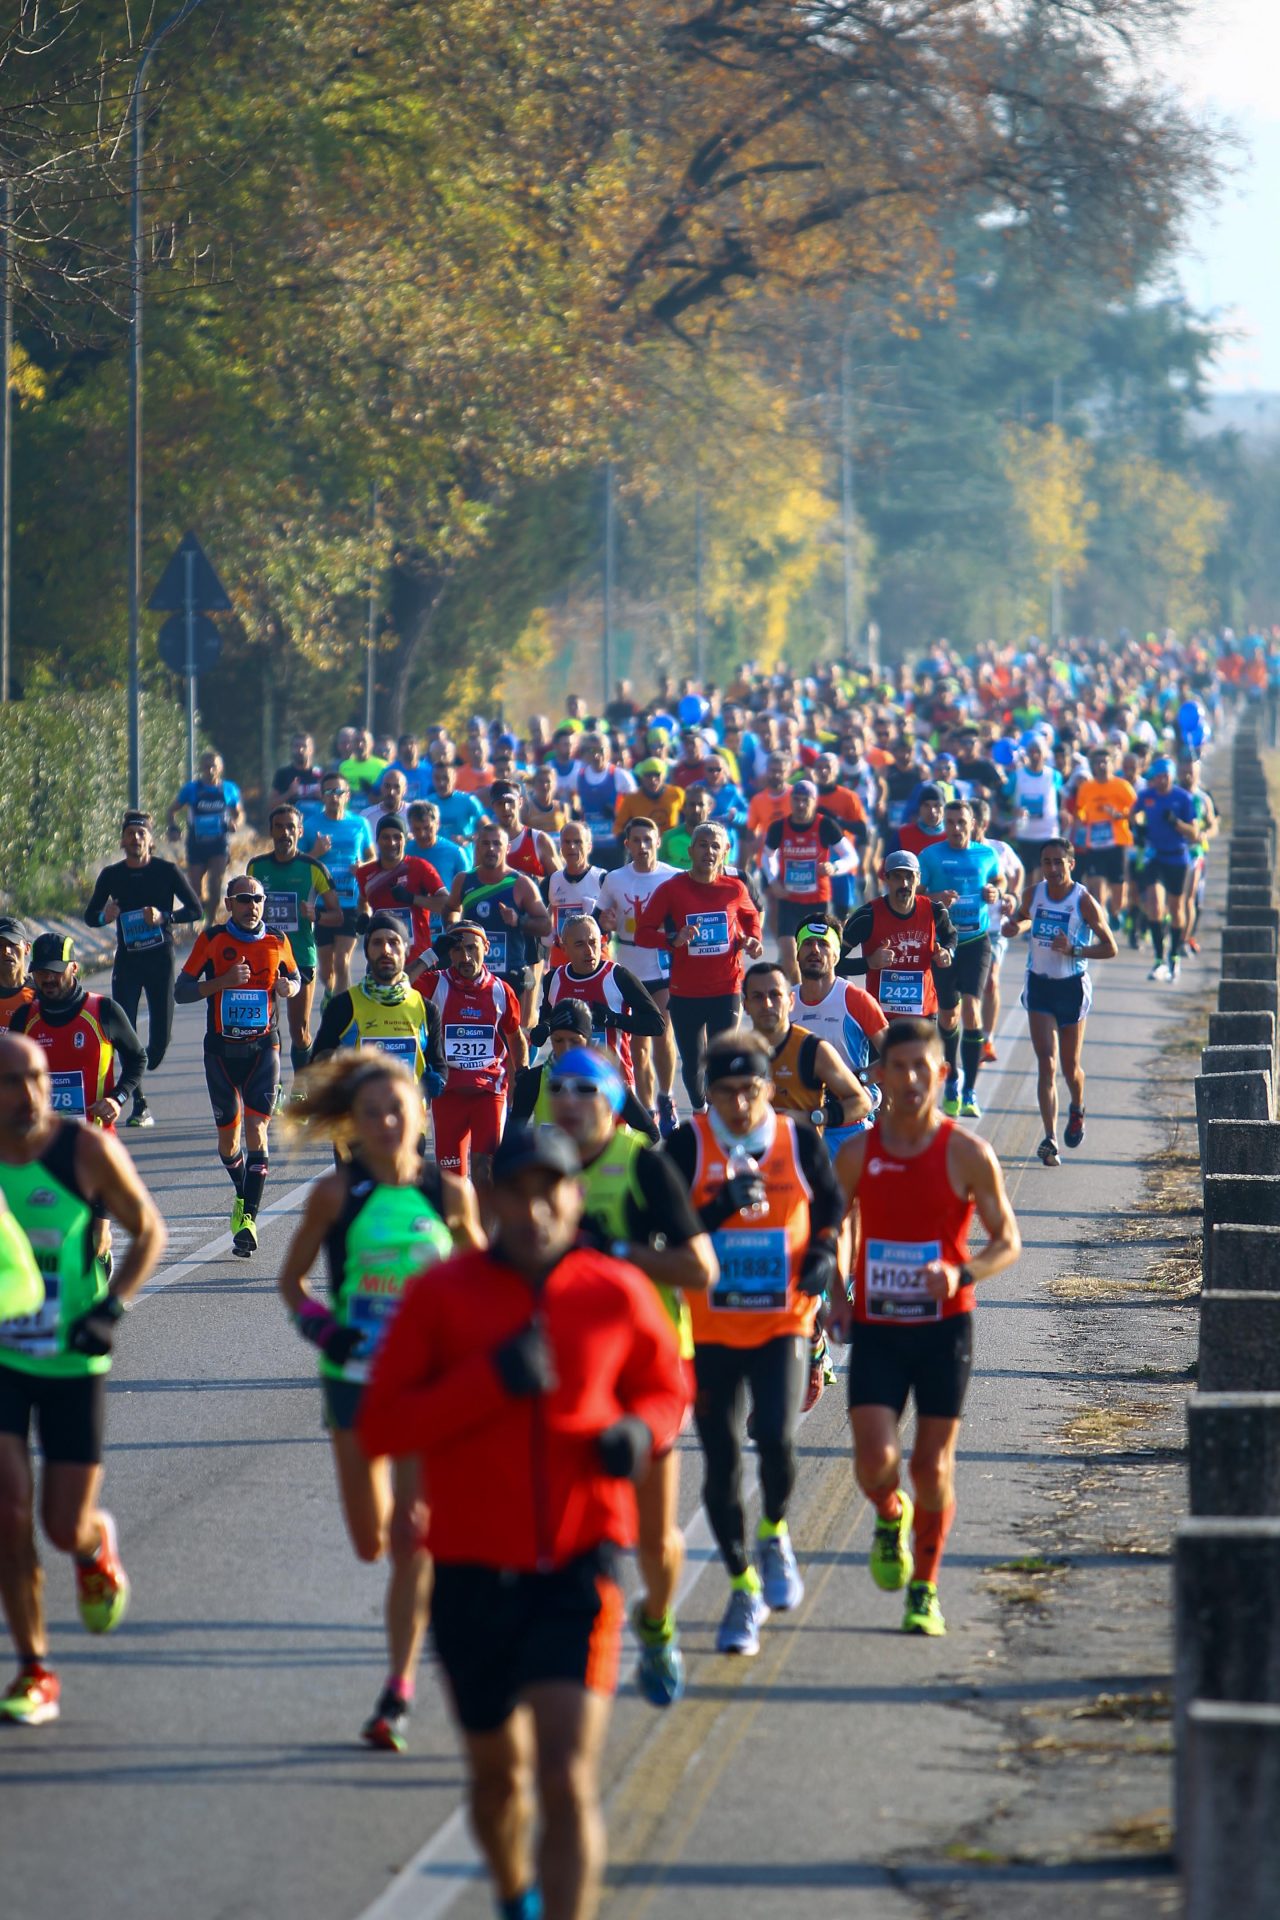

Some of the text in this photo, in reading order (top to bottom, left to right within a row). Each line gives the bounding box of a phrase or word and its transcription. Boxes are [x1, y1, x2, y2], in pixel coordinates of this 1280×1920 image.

[267, 907, 288, 918] 313
[701, 929, 715, 940] 81
[1039, 923, 1060, 936] 556
[231, 992, 260, 1001] Joma
[885, 986, 918, 998] 2422
[228, 1007, 261, 1019] H733
[452, 1043, 487, 1056] 2312
[459, 1060, 485, 1070] Joma
